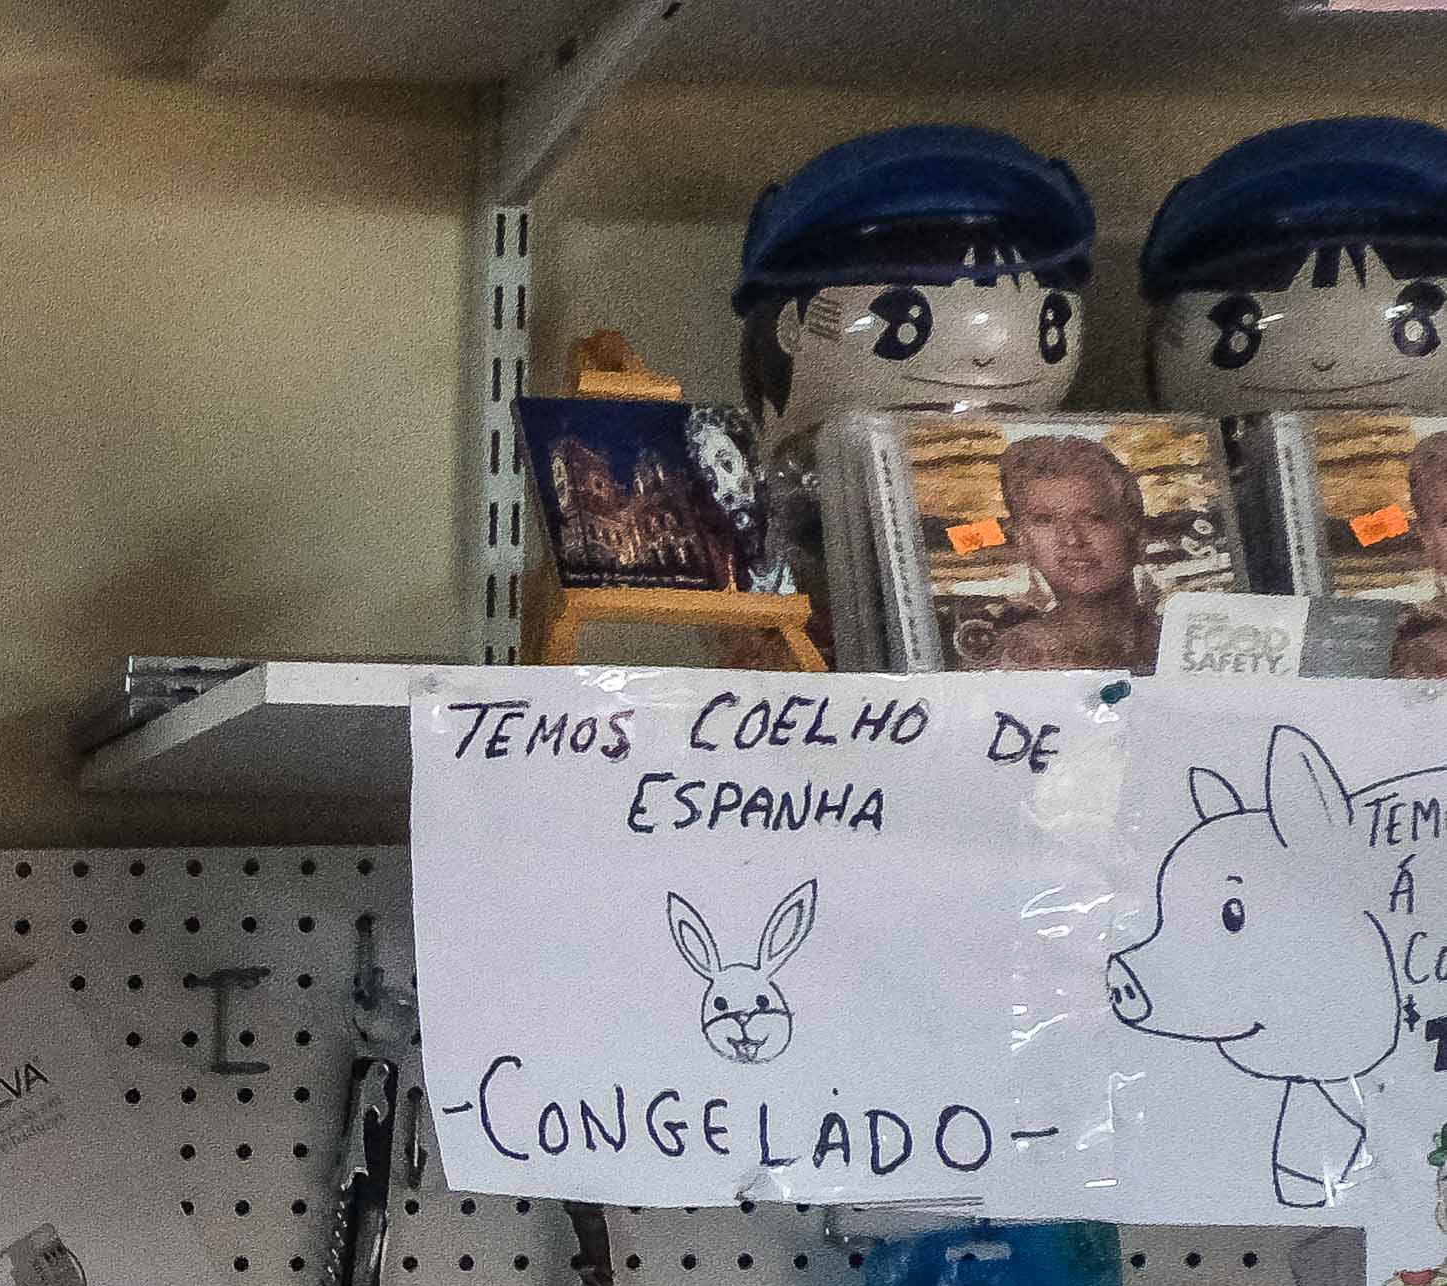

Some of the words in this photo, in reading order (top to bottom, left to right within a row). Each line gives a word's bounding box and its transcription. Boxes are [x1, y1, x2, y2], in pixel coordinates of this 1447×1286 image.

[447, 699, 635, 761] TEMOS
[689, 690, 930, 755] COELHO
[986, 710, 1062, 775] DE
[626, 771, 887, 835] ESPANHA
[1364, 792, 1447, 848] TEM
